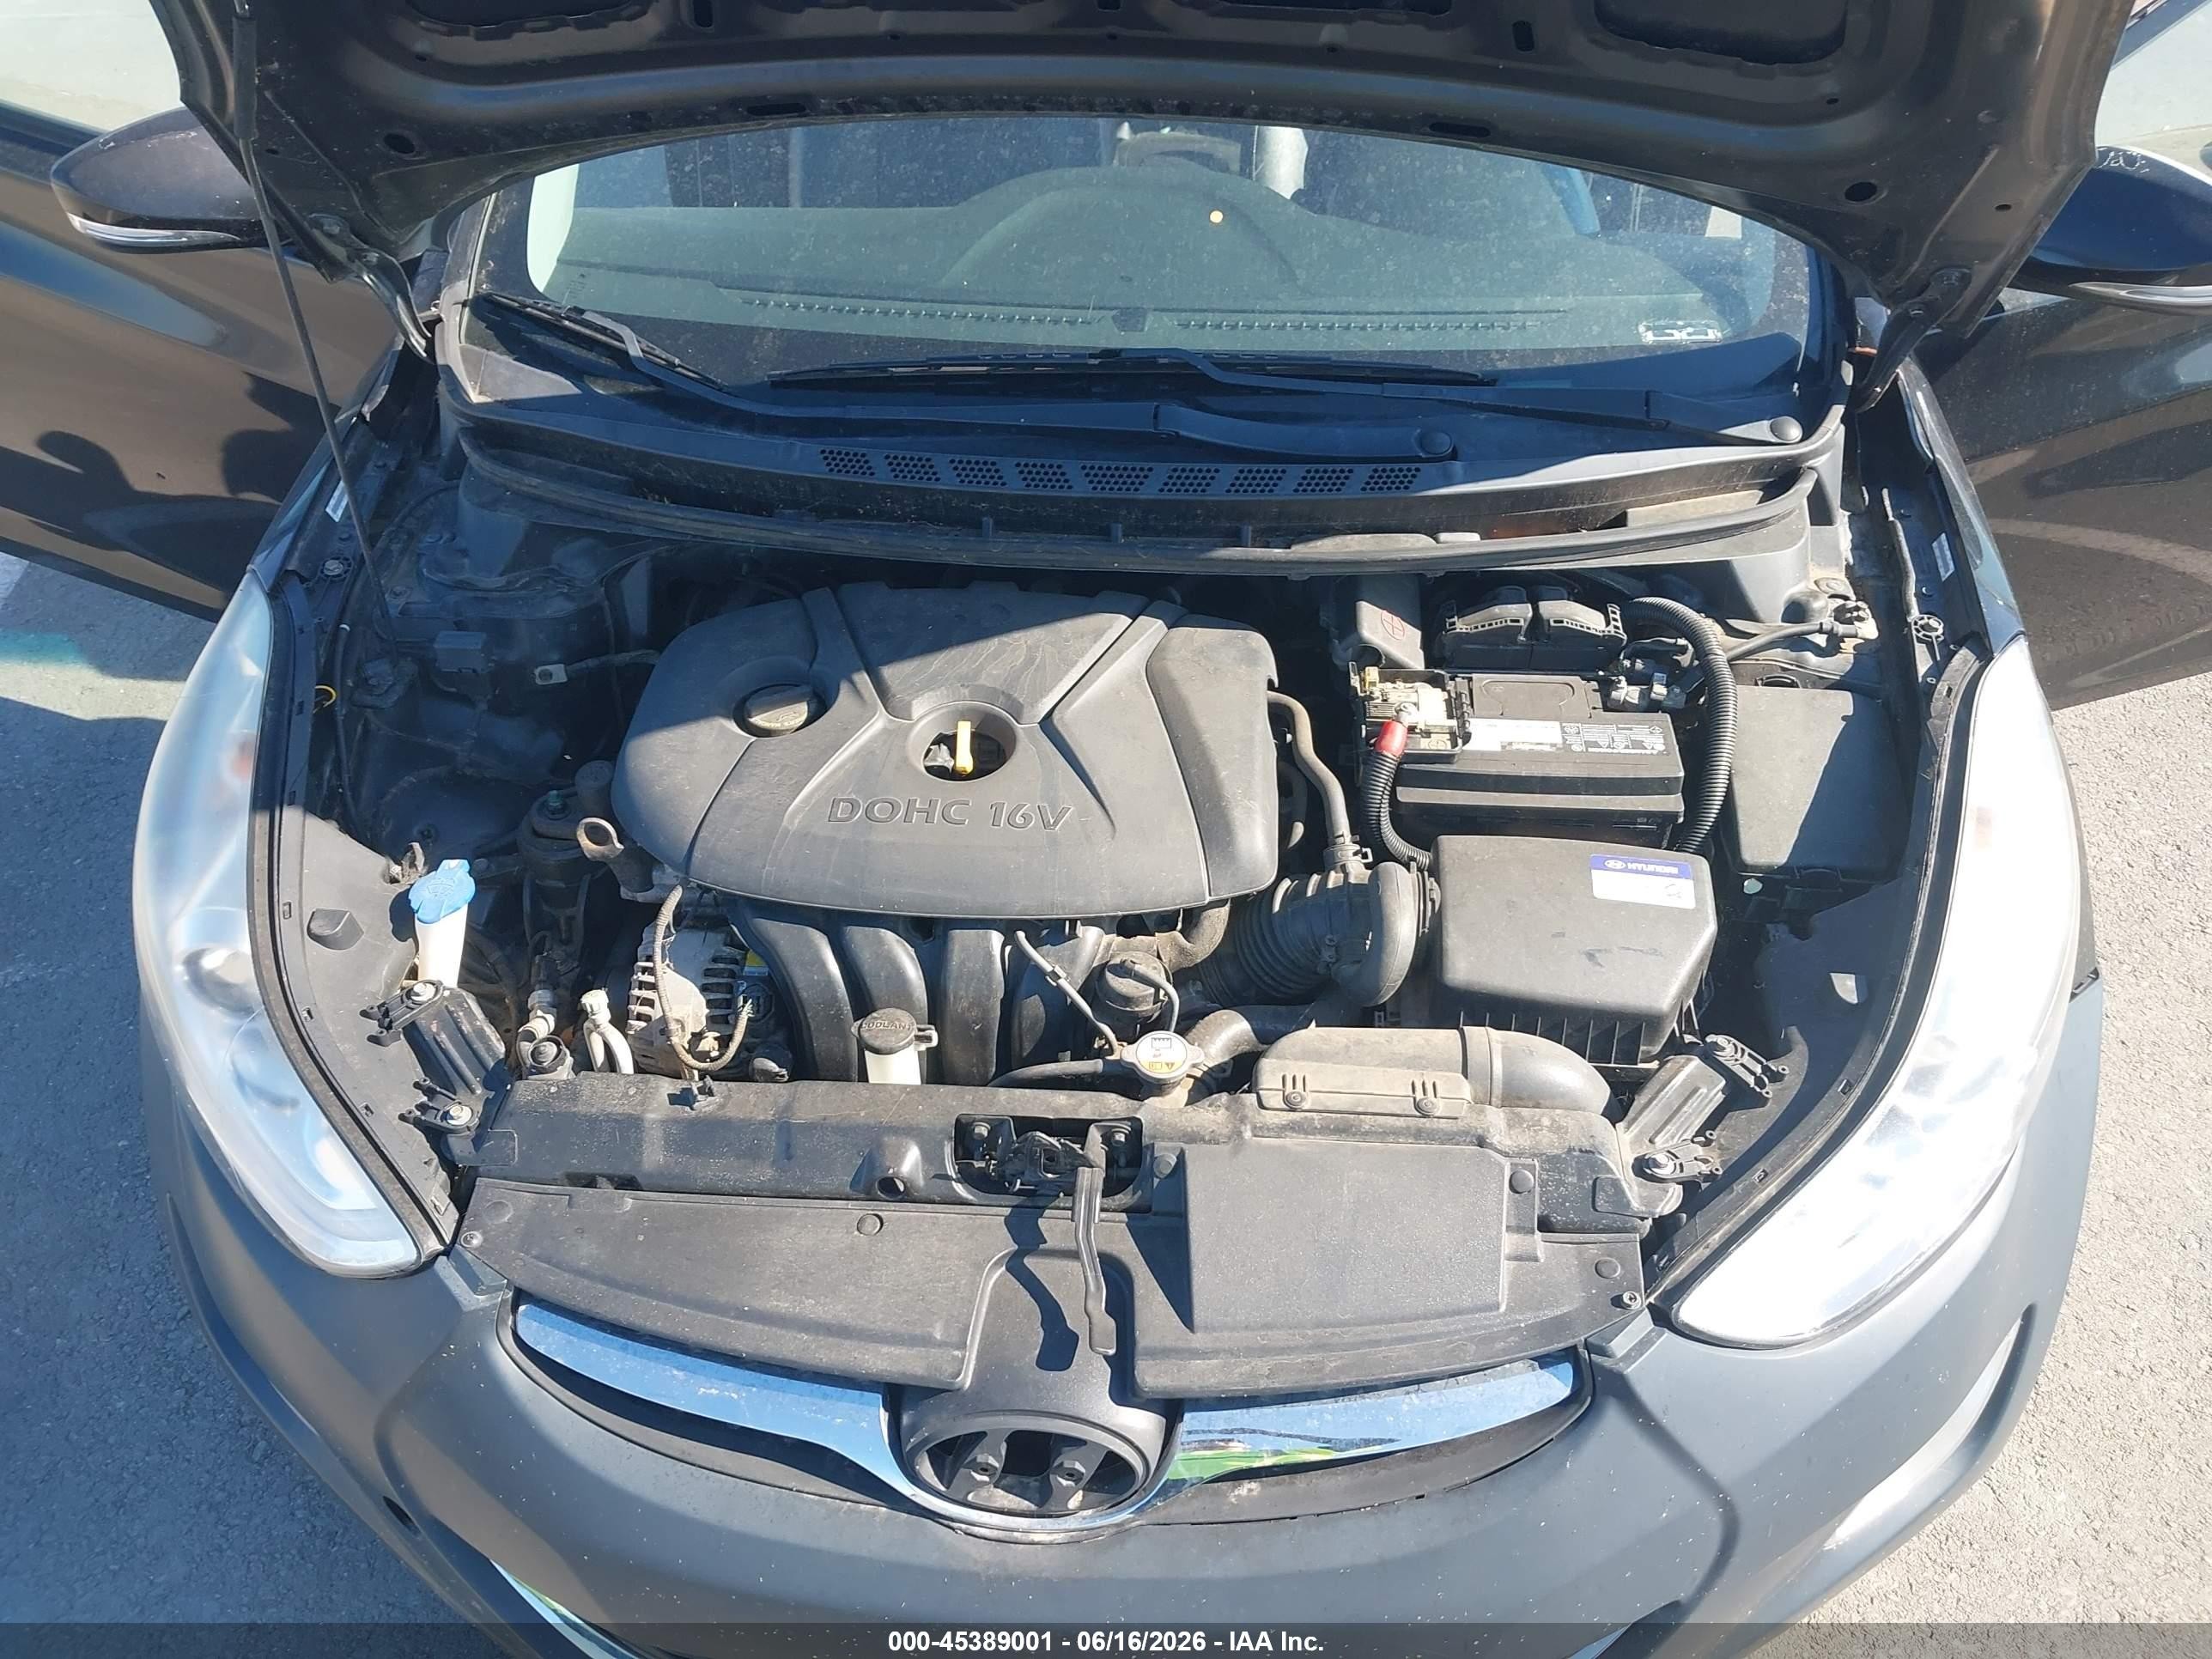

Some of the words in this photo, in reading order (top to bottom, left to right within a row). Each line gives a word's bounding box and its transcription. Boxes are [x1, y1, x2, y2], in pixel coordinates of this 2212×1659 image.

[828, 796, 970, 825] DOHC
[989, 802, 1072, 830] 16V
[860, 1021, 911, 1031] COOLANT
